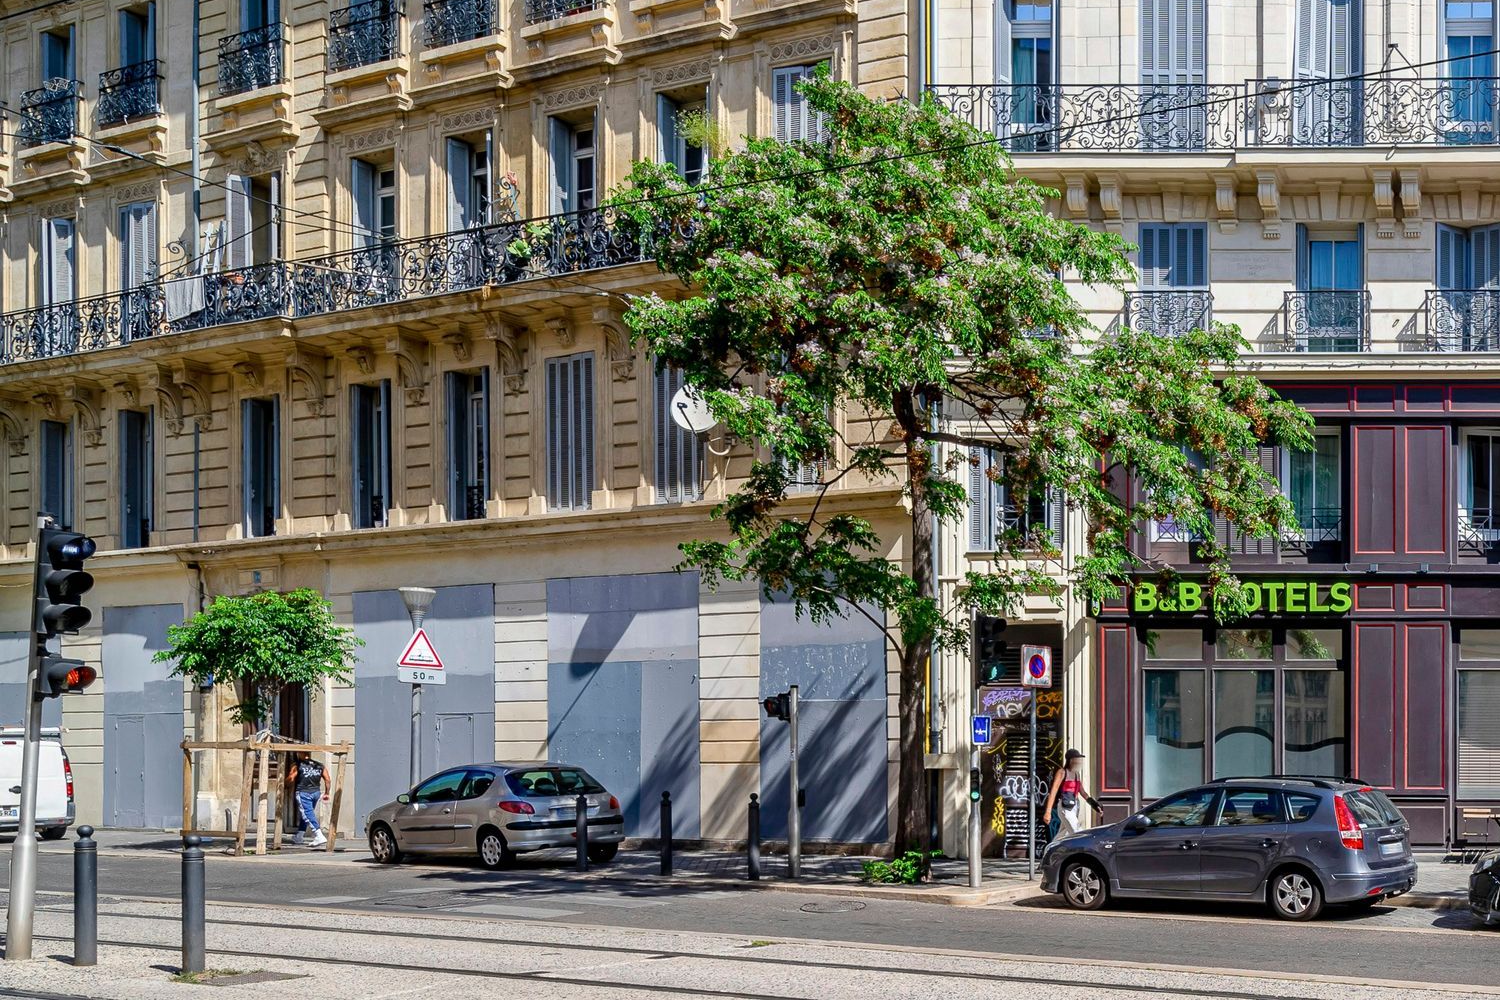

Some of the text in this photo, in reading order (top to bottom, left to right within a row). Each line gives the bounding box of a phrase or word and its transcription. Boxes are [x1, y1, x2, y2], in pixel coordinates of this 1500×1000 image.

[1134, 582, 1352, 612] B&B OTELS
[413, 672, 426, 680] 50
